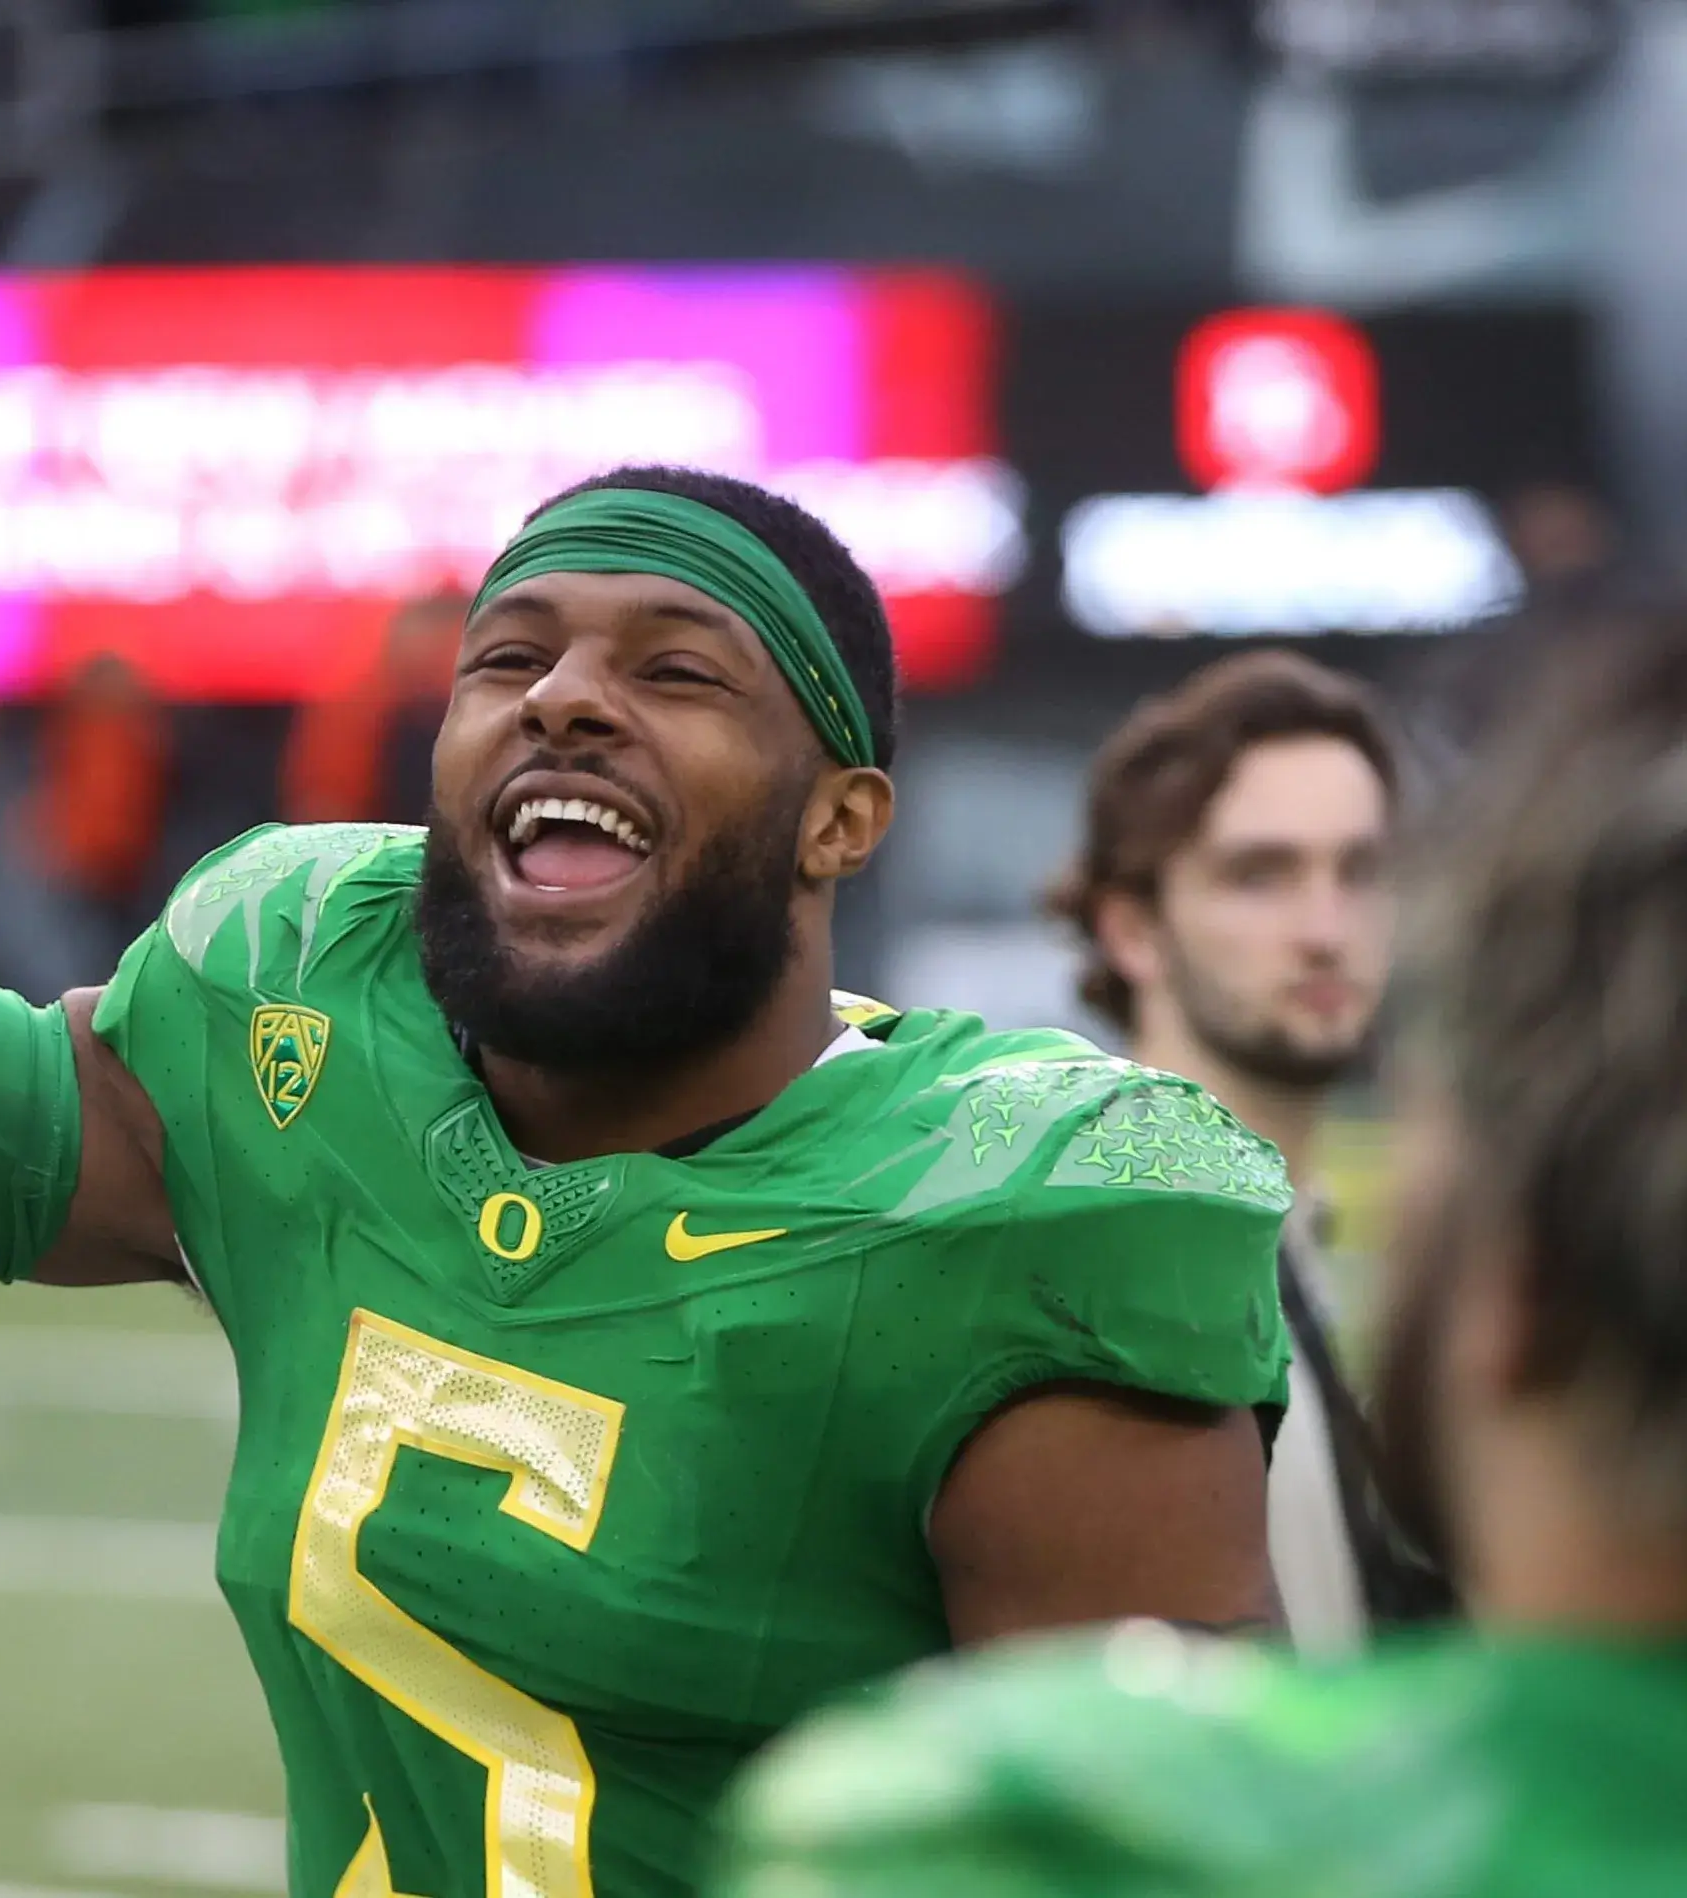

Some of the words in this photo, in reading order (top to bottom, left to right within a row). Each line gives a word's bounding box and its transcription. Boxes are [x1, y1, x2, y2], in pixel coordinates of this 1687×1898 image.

[255, 1012, 324, 1080] PAC
[268, 1060, 304, 1102] 12
[479, 1192, 542, 1260] O
[288, 1306, 626, 1898] 5
